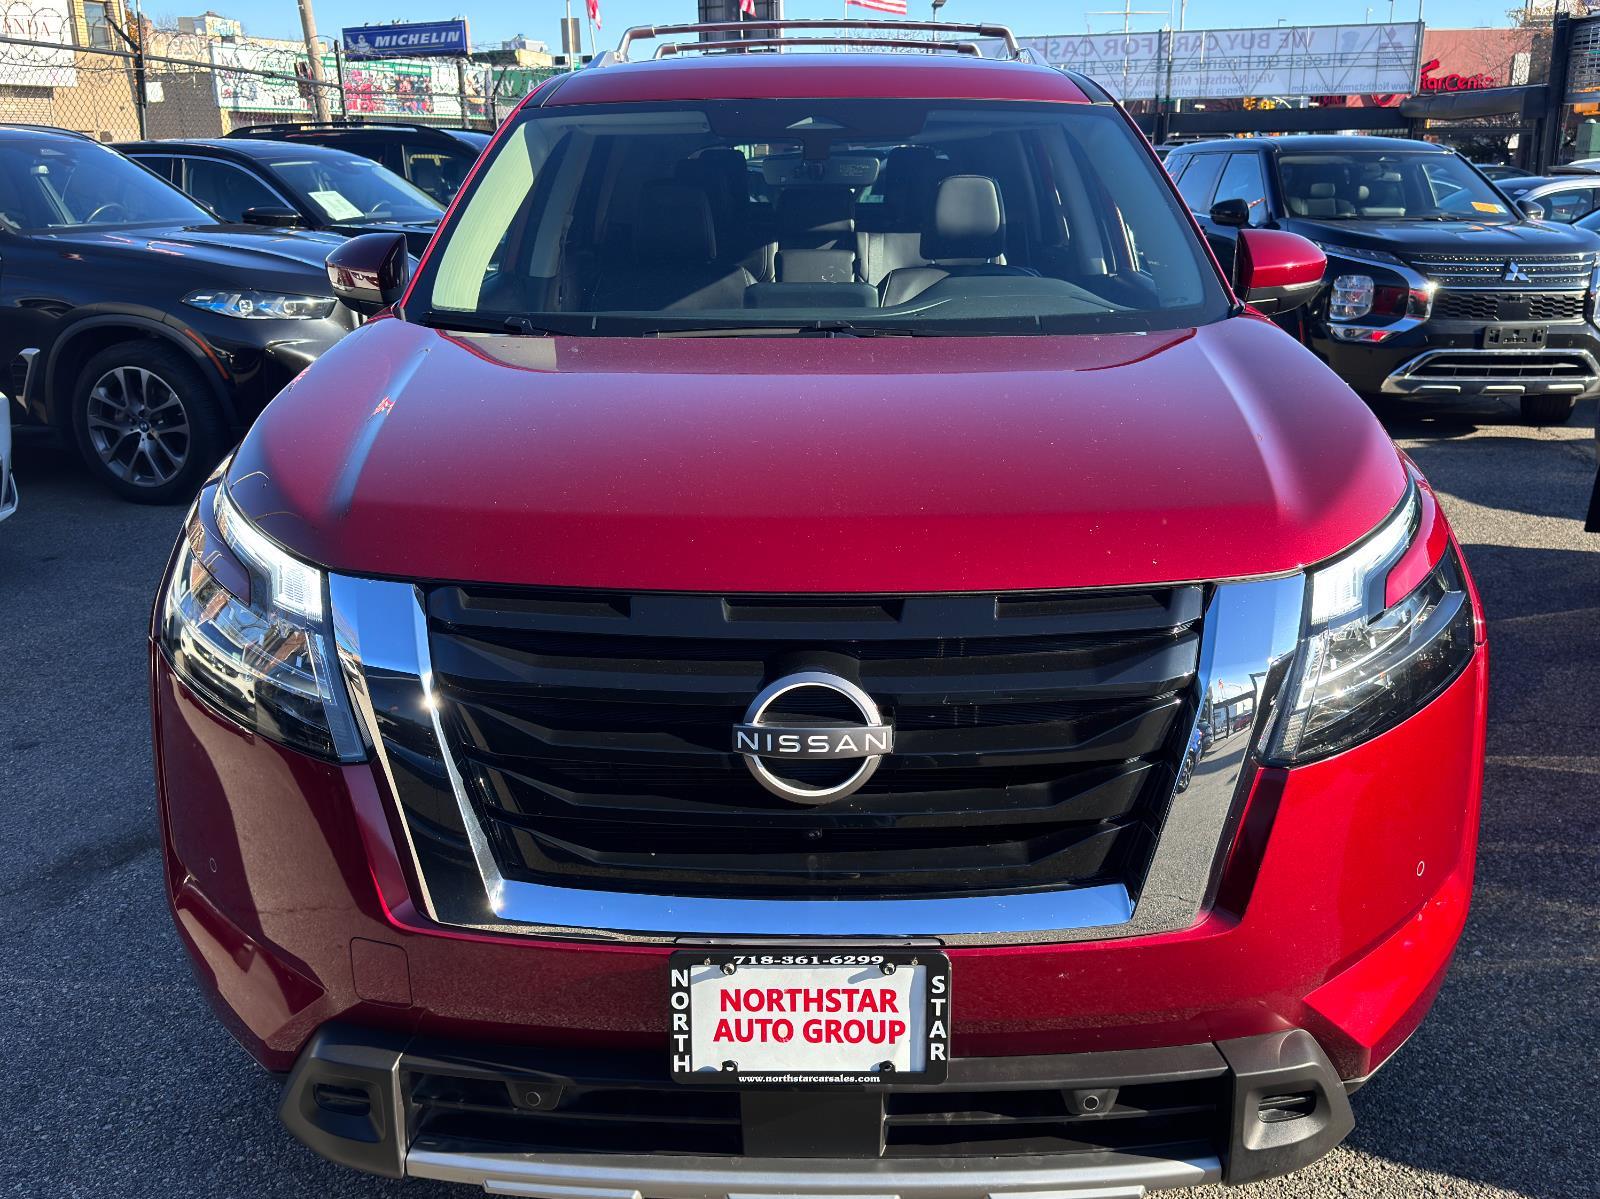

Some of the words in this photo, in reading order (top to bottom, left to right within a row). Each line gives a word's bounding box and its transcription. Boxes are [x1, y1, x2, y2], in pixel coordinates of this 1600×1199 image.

[374, 31, 460, 47] MICHELIN
[737, 731, 887, 753] NISSAN
[733, 955, 884, 965] 718-361-6299
[720, 989, 899, 1013] NORTHSTAR
[671, 969, 690, 1072] NORTH
[930, 976, 946, 1061] STAR
[713, 1019, 794, 1043] AUTO
[802, 1020, 906, 1044] GROUP
[738, 1074, 881, 1083] www.northstarcarsales.com
